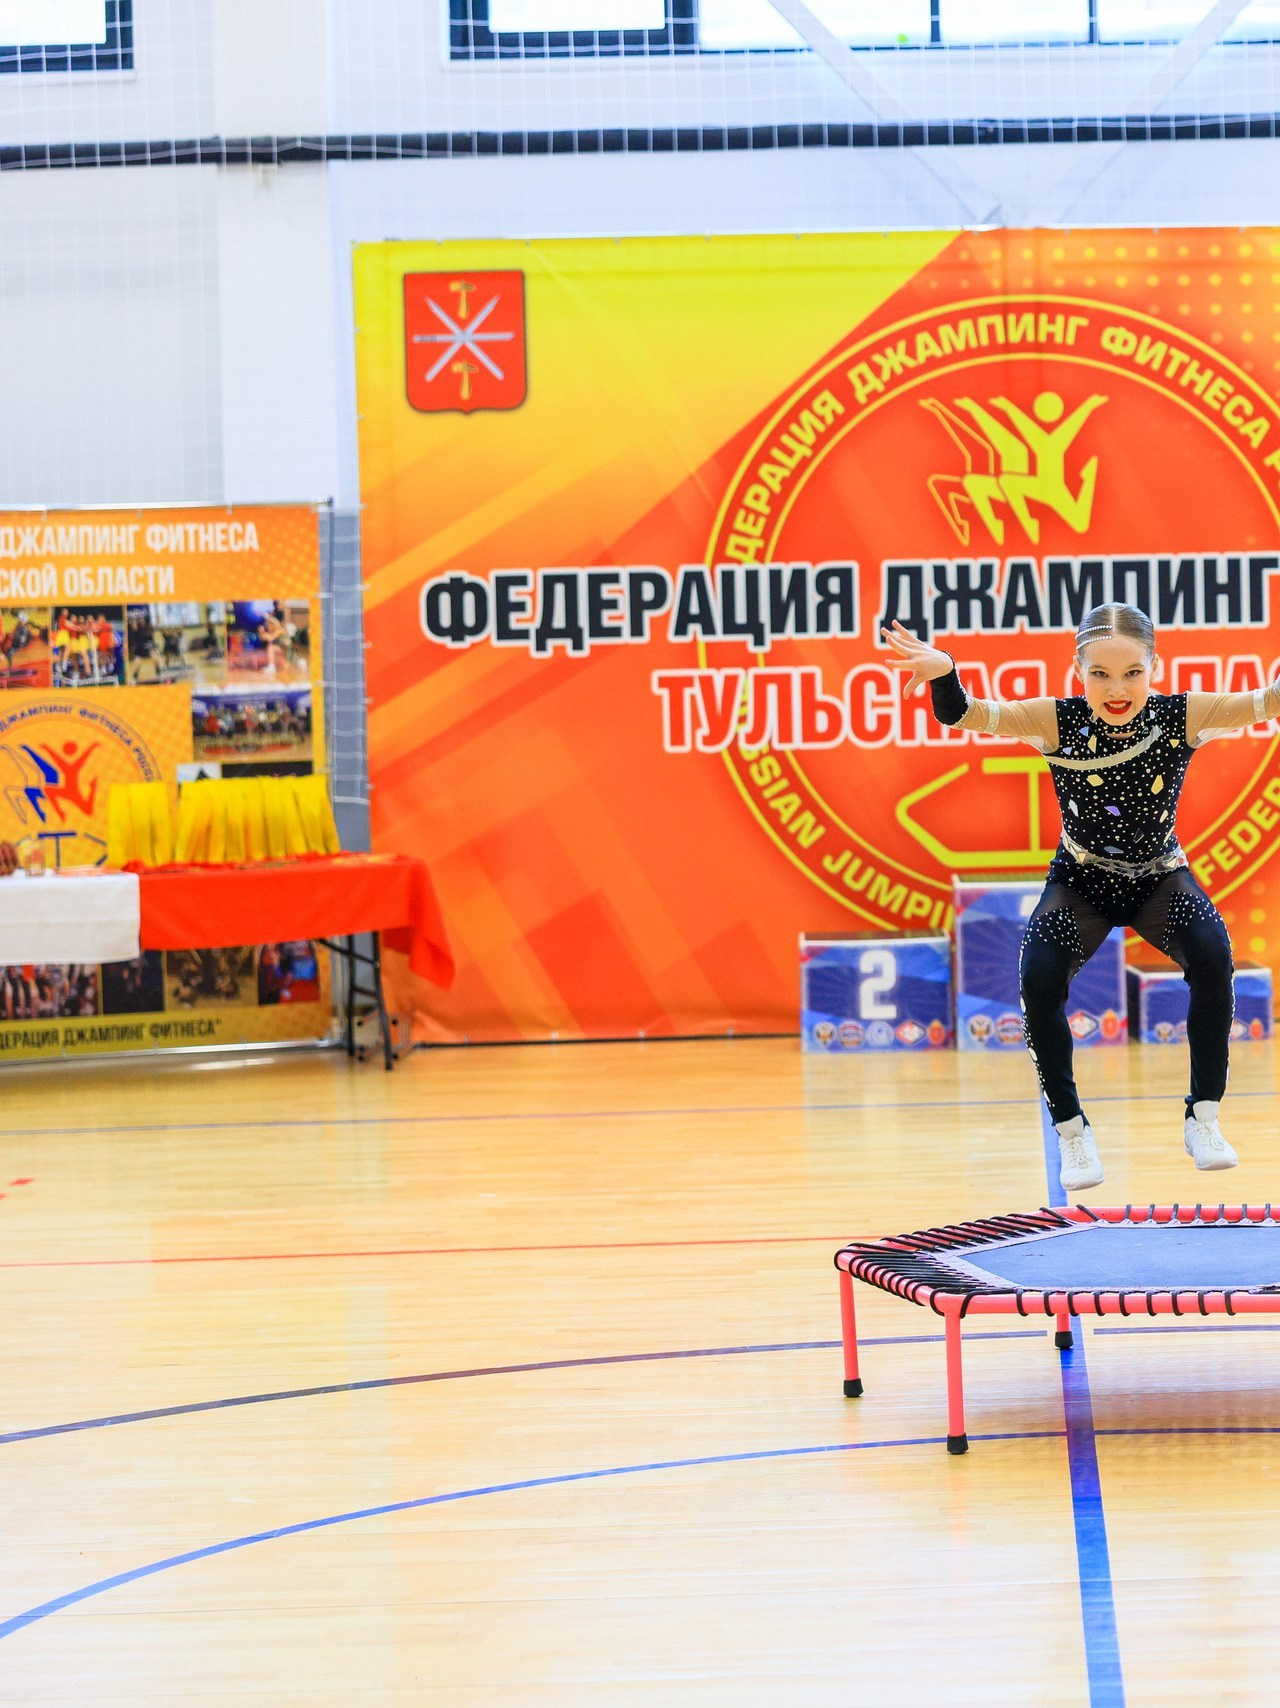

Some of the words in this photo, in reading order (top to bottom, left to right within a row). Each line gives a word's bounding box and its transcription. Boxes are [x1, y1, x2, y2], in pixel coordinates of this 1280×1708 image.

[847, 313, 1089, 404] ДЖАМПИНГ
[1101, 326, 1270, 449] ФИТНЕСА
[0, 525, 140, 559] ДЖАМПИНГ
[145, 522, 260, 554] ФИТНЕСА
[64, 565, 175, 597] ОБЛАСТИ
[424, 564, 858, 654] ФЕДЕРАЦИЯ
[859, 950, 897, 1020] 2
[63, 1023, 145, 1046] ДЖАМПИНГ
[149, 1018, 222, 1039] ФИТНЕСА"
